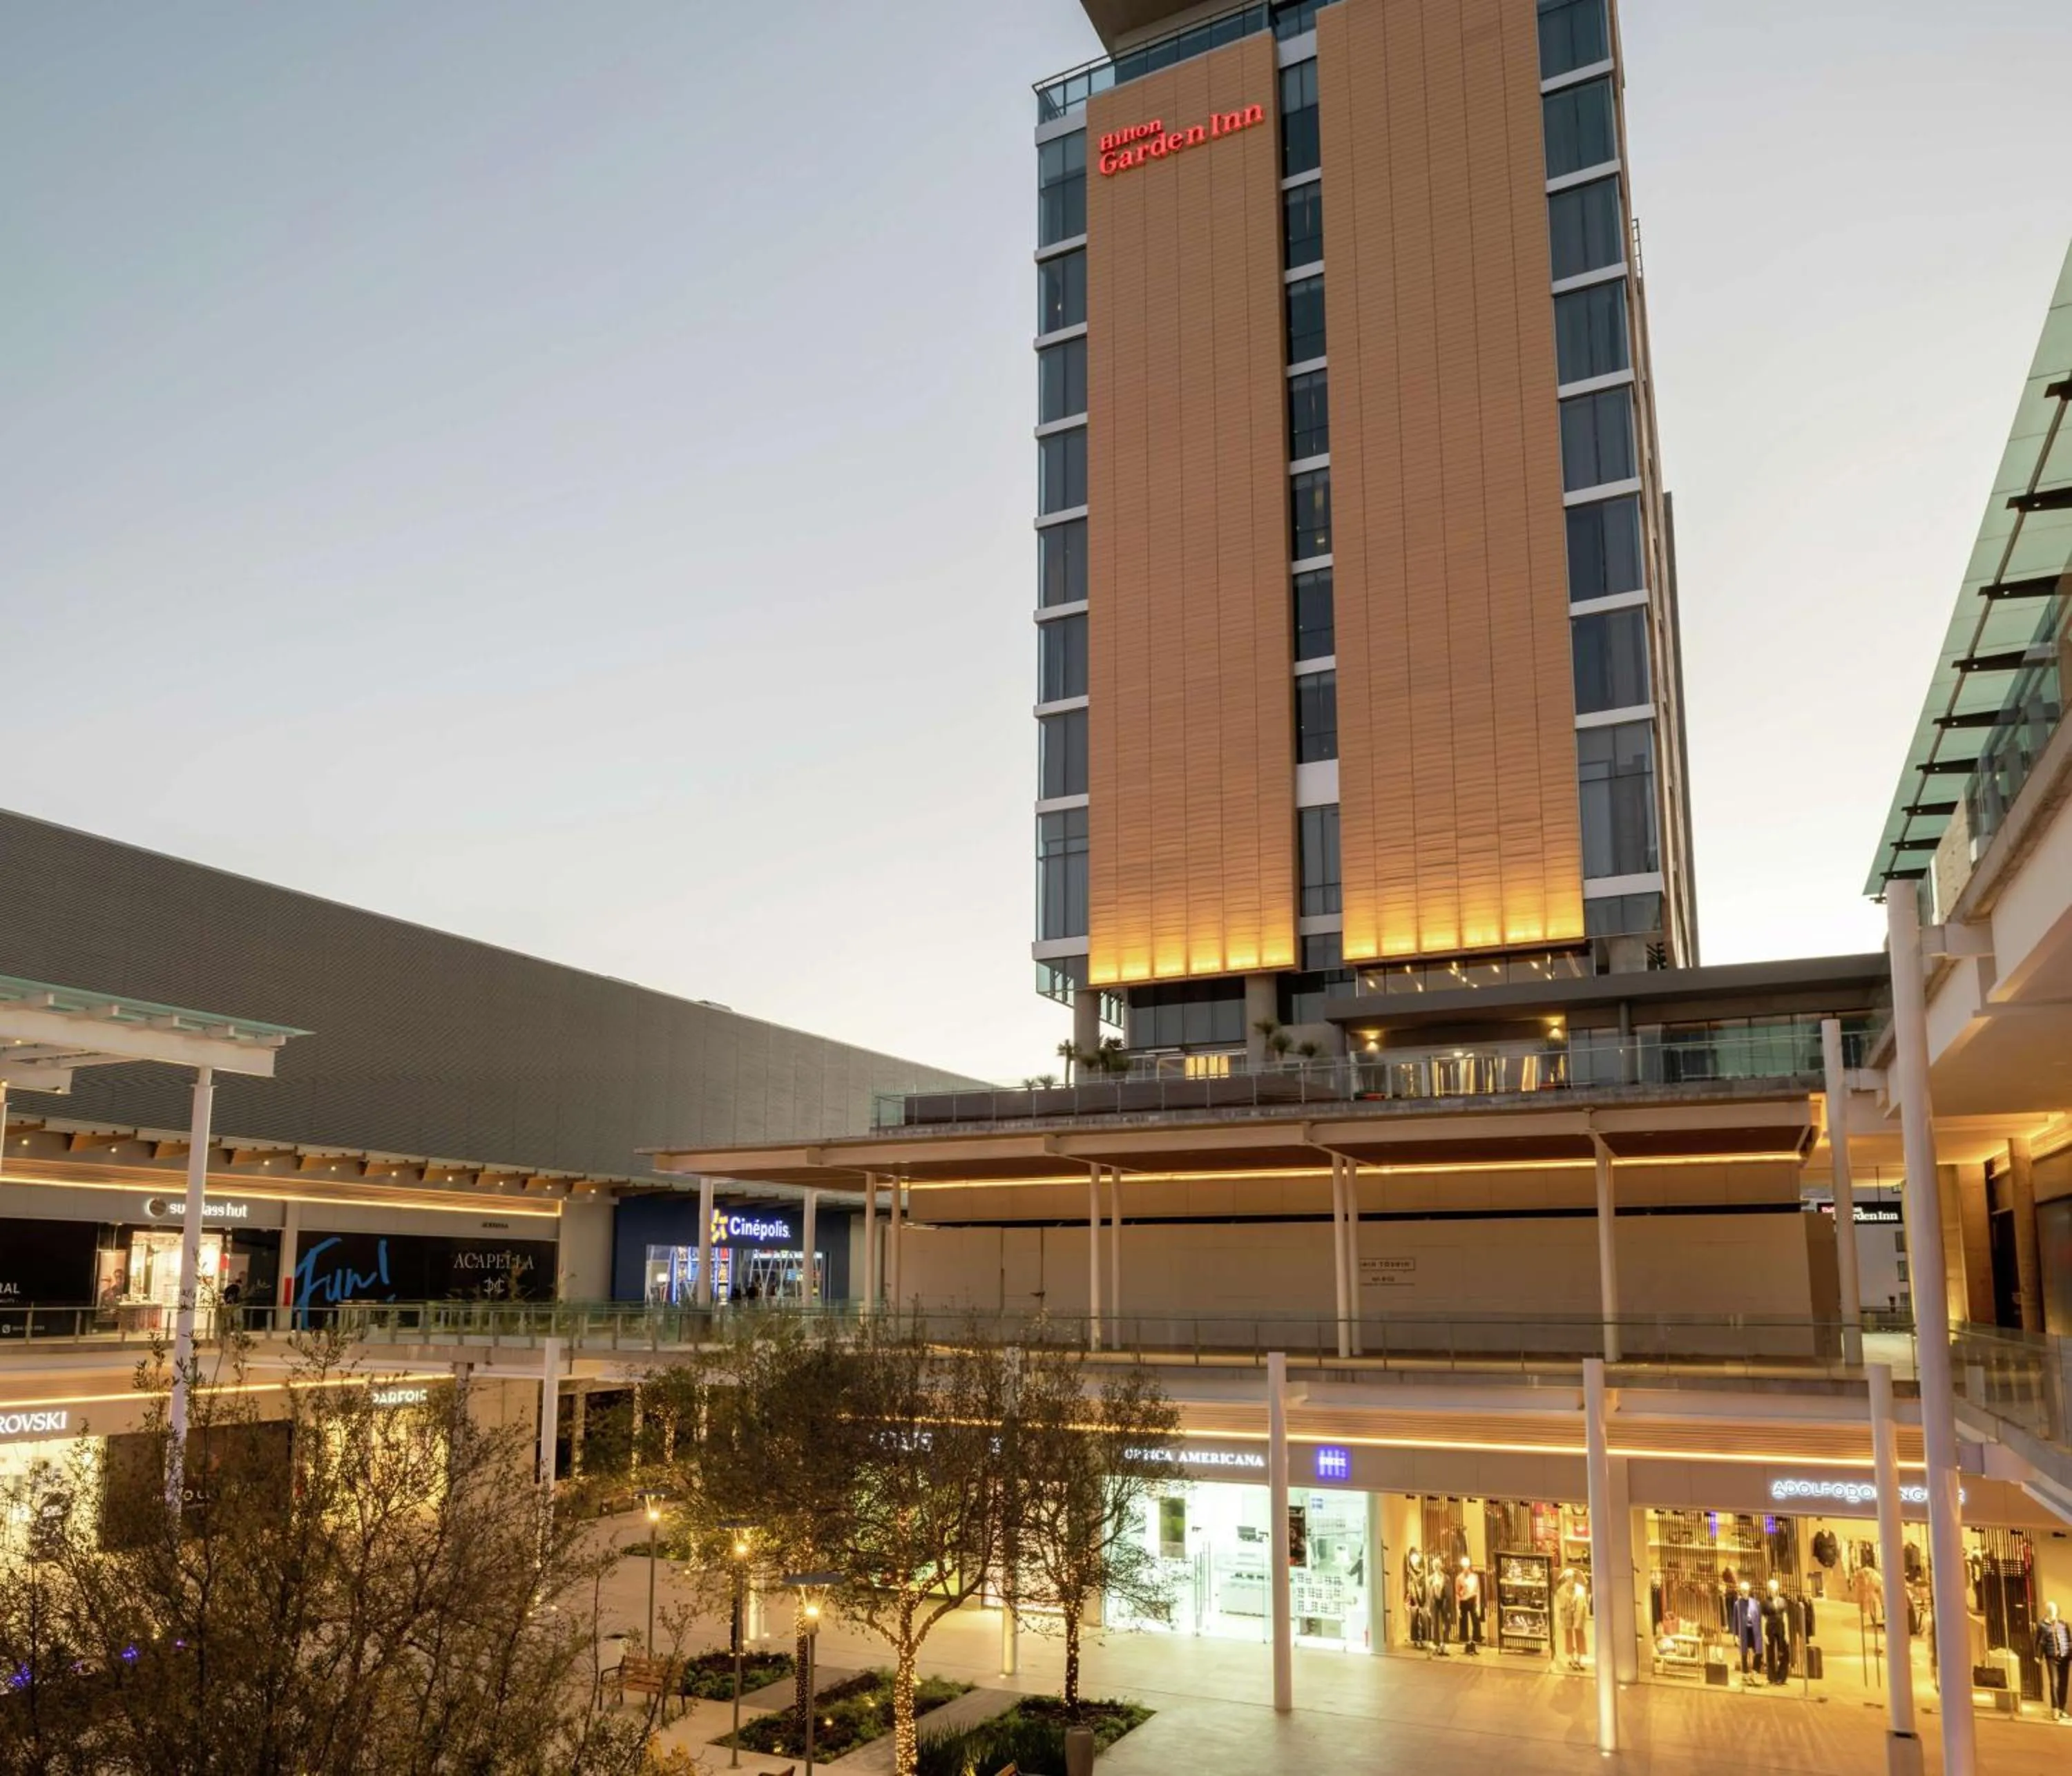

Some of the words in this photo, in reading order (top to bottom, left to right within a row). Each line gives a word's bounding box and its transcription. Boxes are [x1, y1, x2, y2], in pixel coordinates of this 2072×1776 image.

[1099, 125, 1205, 176] Garden
[1211, 104, 1265, 137] Inn
[1100, 119, 1162, 152] Hilton
[169, 1201, 224, 1216] sulass
[226, 1202, 247, 1217] hut
[1878, 1210, 1899, 1221] Inn
[1178, 1451, 1264, 1467] AMERICANA
